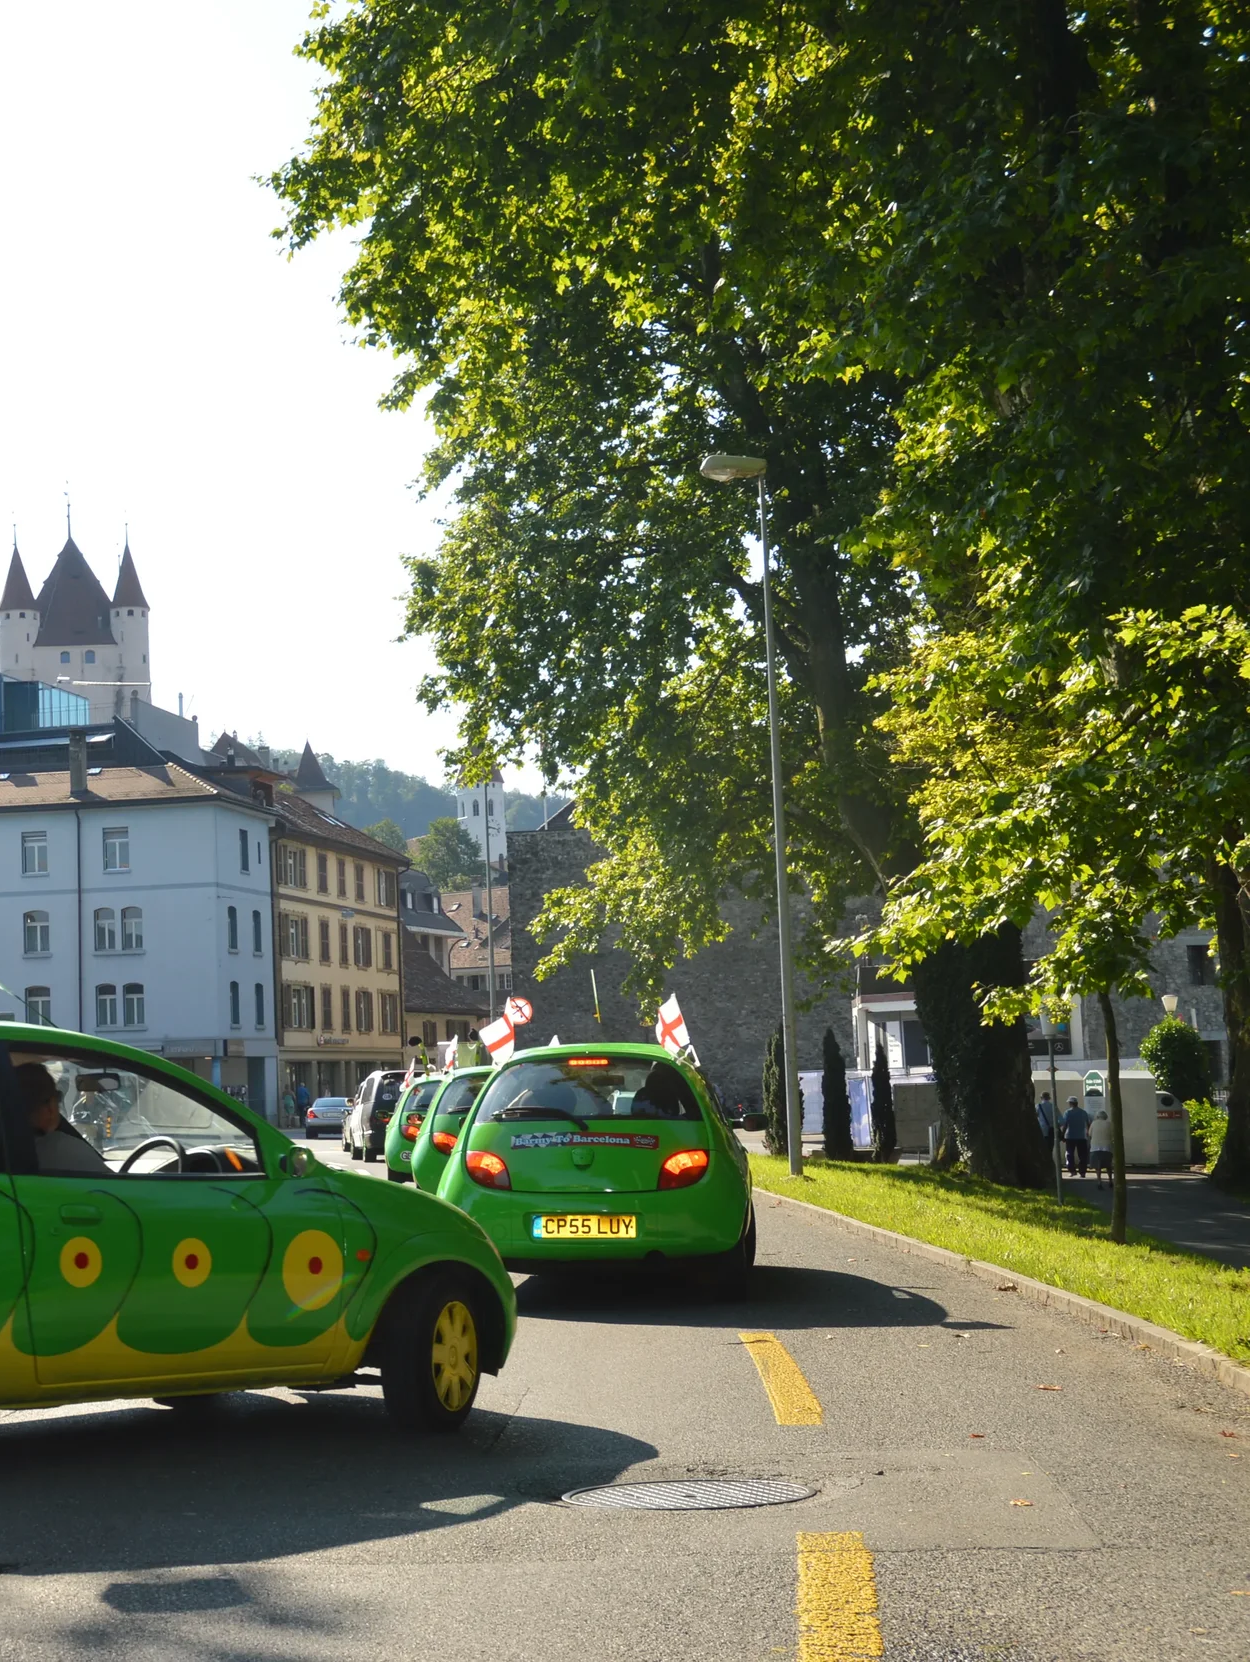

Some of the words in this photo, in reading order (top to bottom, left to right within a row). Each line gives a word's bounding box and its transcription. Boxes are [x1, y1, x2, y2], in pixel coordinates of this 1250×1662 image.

[515, 1137, 552, 1146] Barmy
[555, 1135, 570, 1143] To
[573, 1134, 630, 1144] Barcelona
[545, 1218, 591, 1234] CP55
[597, 1218, 632, 1235] LUY
